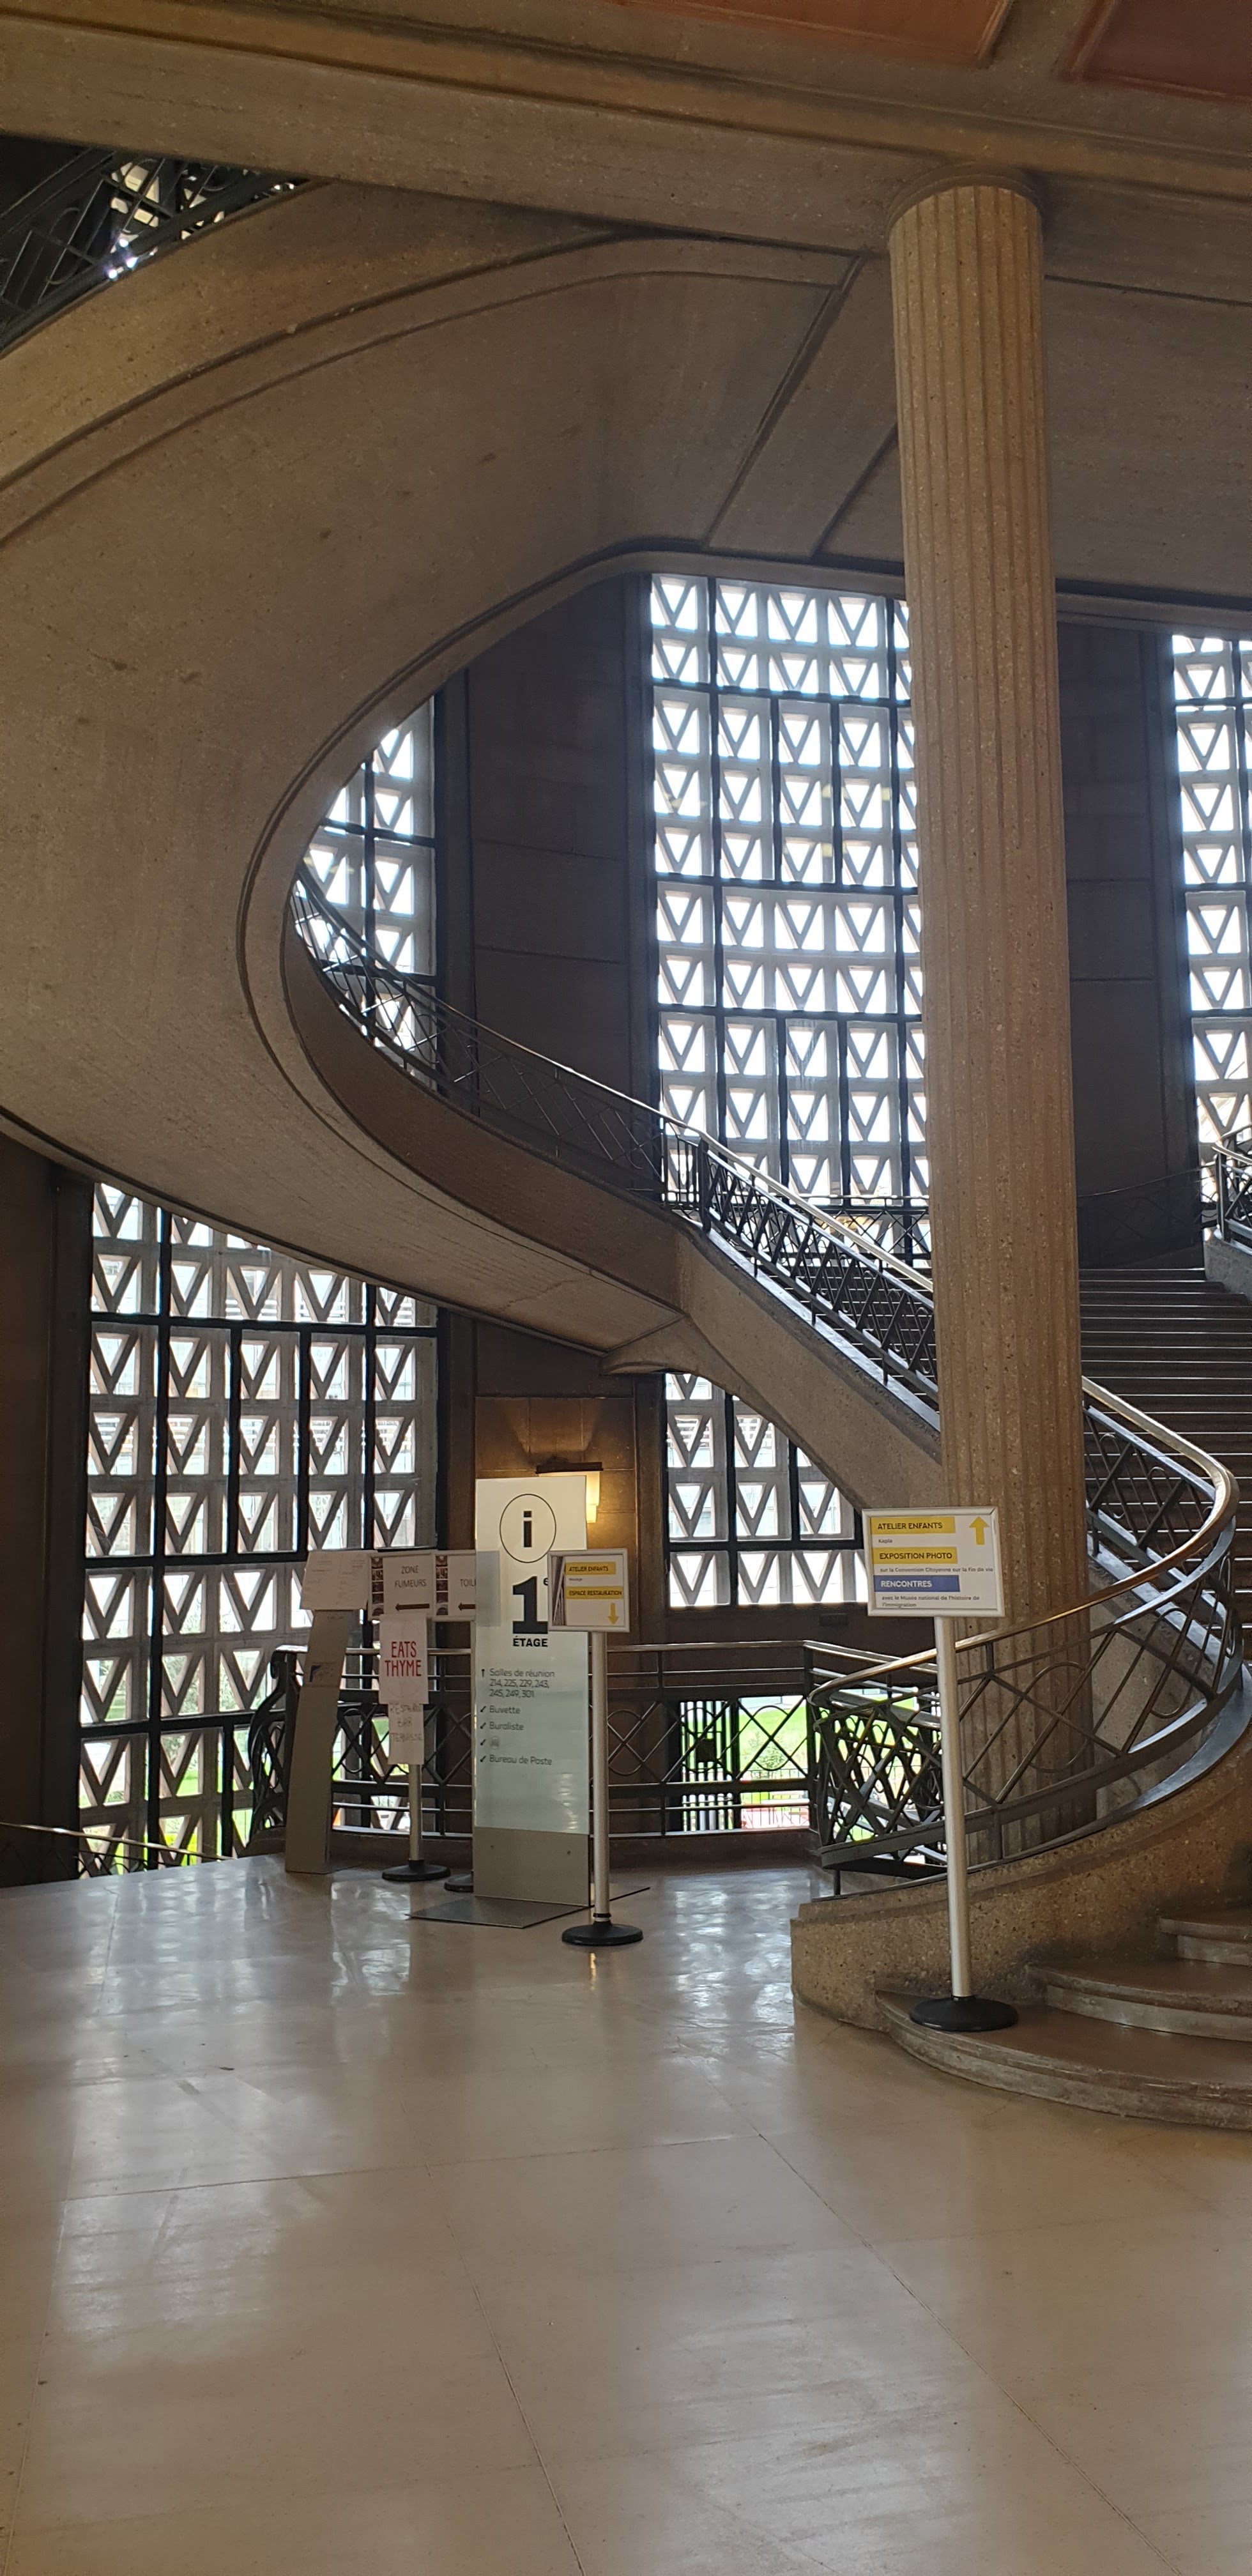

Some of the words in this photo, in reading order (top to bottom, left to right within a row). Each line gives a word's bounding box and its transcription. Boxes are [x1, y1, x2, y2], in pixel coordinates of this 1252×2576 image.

[523, 1510, 532, 1547] i
[401, 1565, 419, 1575] ZONE
[394, 1579, 427, 1588] FUMEURS
[460, 1579, 477, 1587] TOIL
[513, 1636, 548, 1647] ÉTAGE
[391, 1641, 416, 1658] EATS
[385, 1660, 422, 1676] THYME
[489, 1668, 512, 1676] Salles
[526, 1669, 555, 1677] réunion
[489, 1678, 503, 1687] 214,
[505, 1679, 518, 1688] 225,
[519, 1679, 534, 1688] 229,
[535, 1680, 550, 1689] 243,
[489, 1689, 505, 1698] 245,
[506, 1689, 521, 1698] 249,
[489, 1705, 521, 1713] Buvette
[489, 1721, 524, 1731] Buraliste
[489, 1754, 517, 1763] Bureau
[519, 1755, 528, 1764] de
[530, 1756, 553, 1765] Poste
